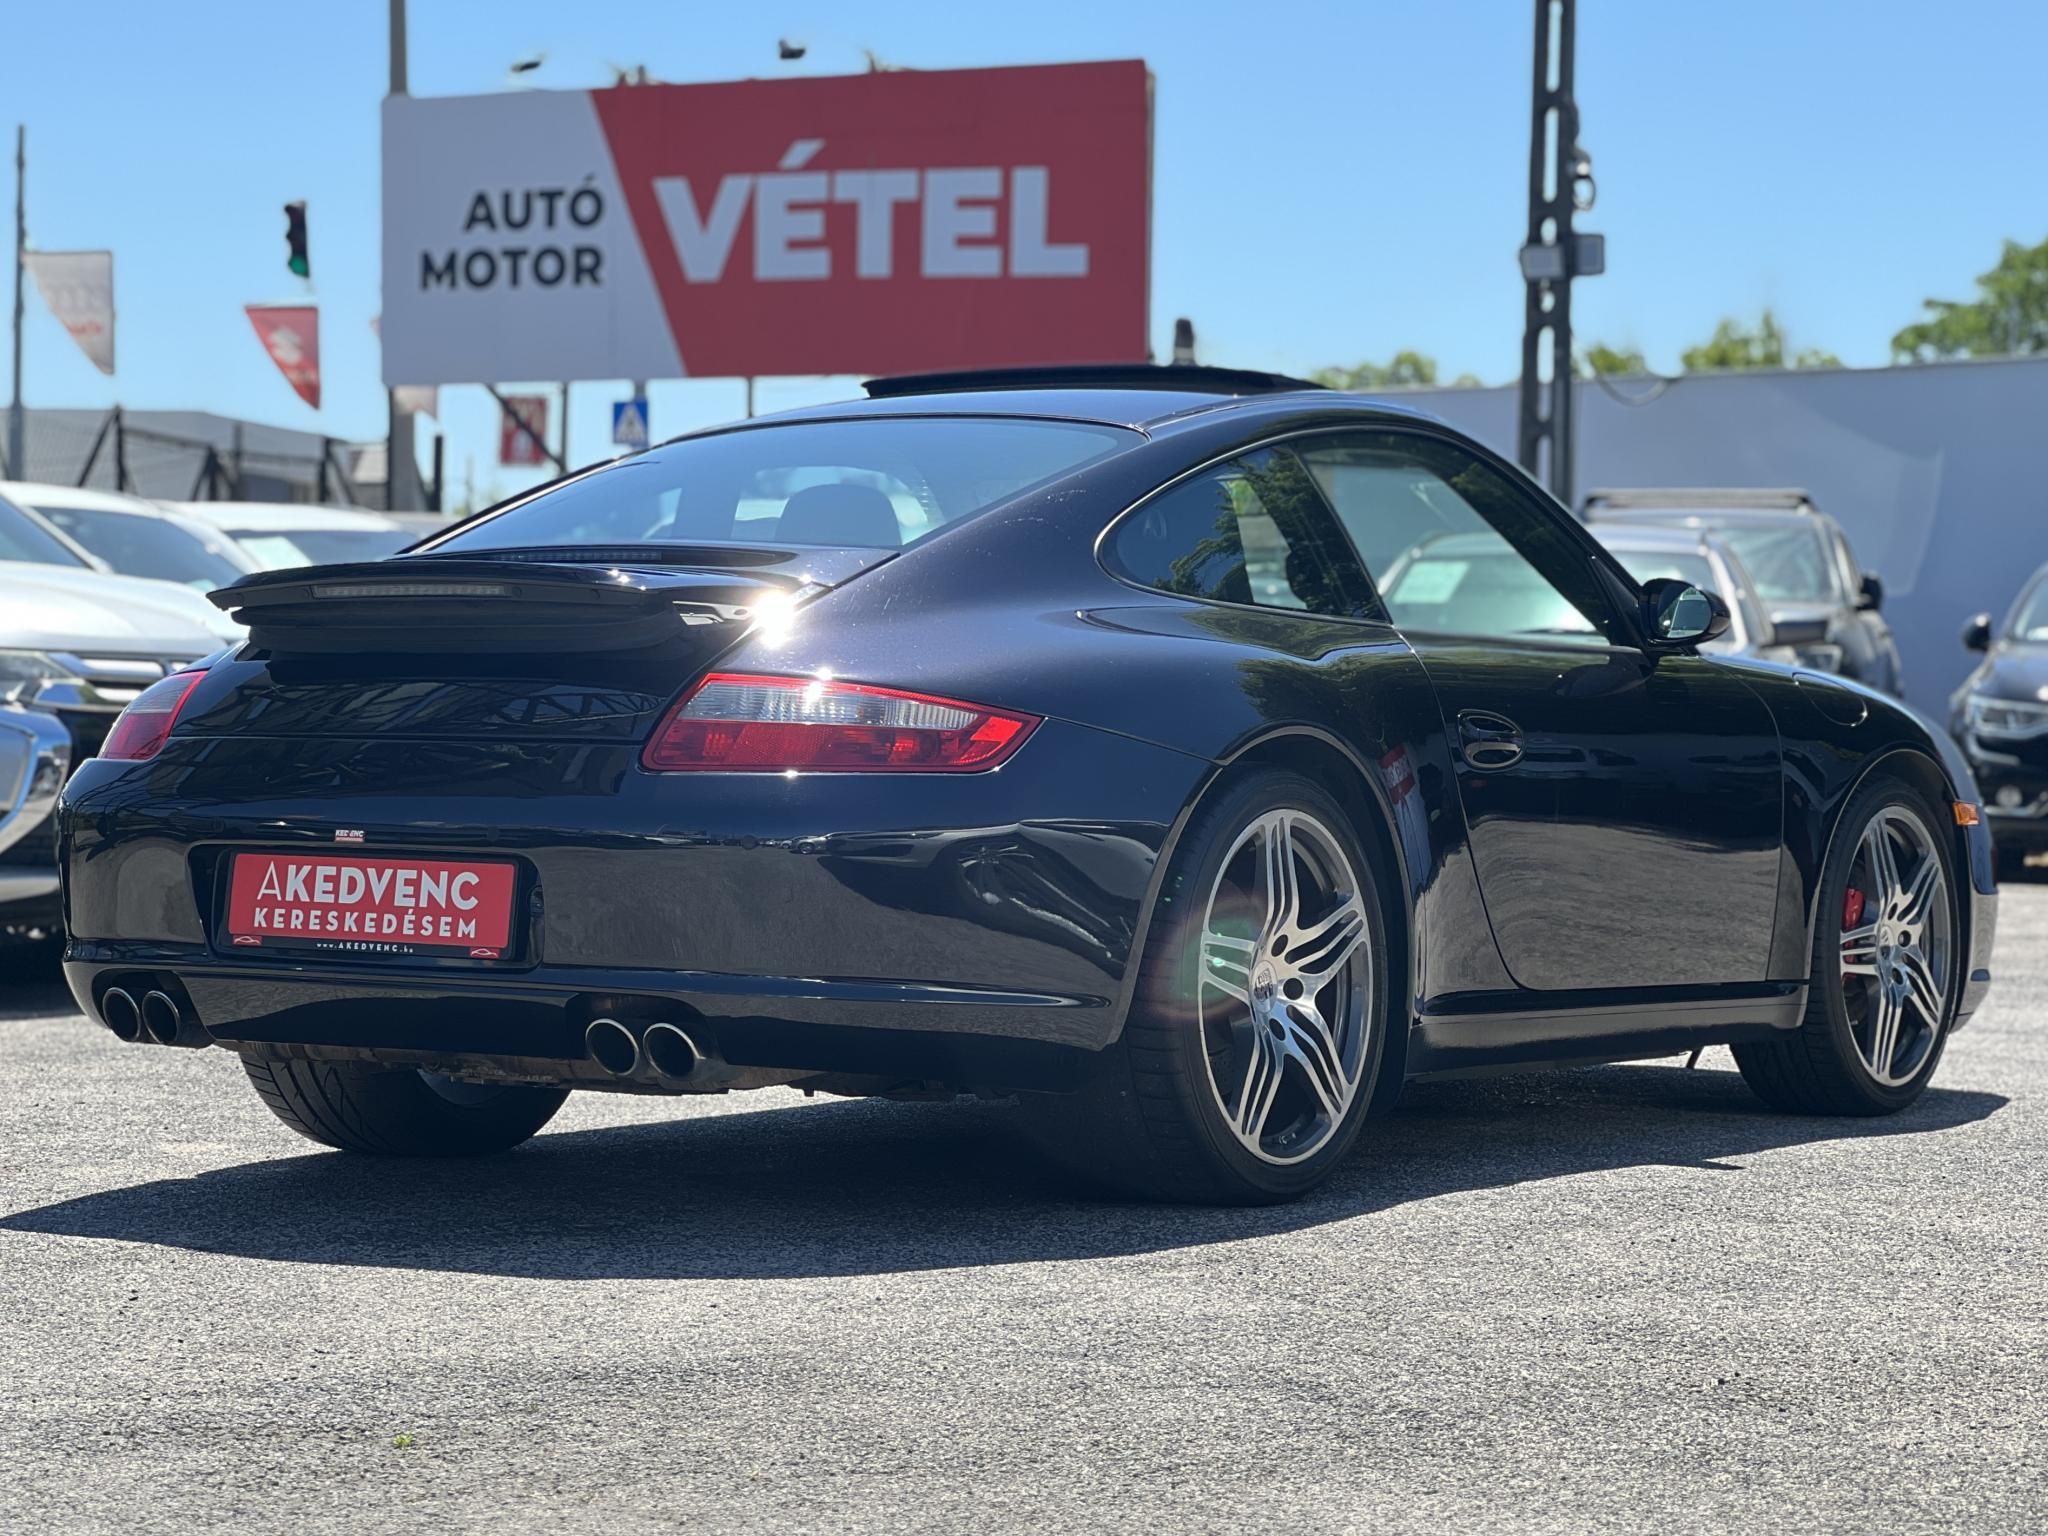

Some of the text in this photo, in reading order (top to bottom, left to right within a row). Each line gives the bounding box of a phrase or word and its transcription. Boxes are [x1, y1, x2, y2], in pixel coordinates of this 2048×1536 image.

[464, 173, 604, 232] AUTÓ
[652, 138, 1090, 283] VÉTEL
[421, 247, 602, 290] MOTOR
[257, 860, 480, 911] AKEDVENC
[253, 906, 477, 939] KERESKEDÉSEM
